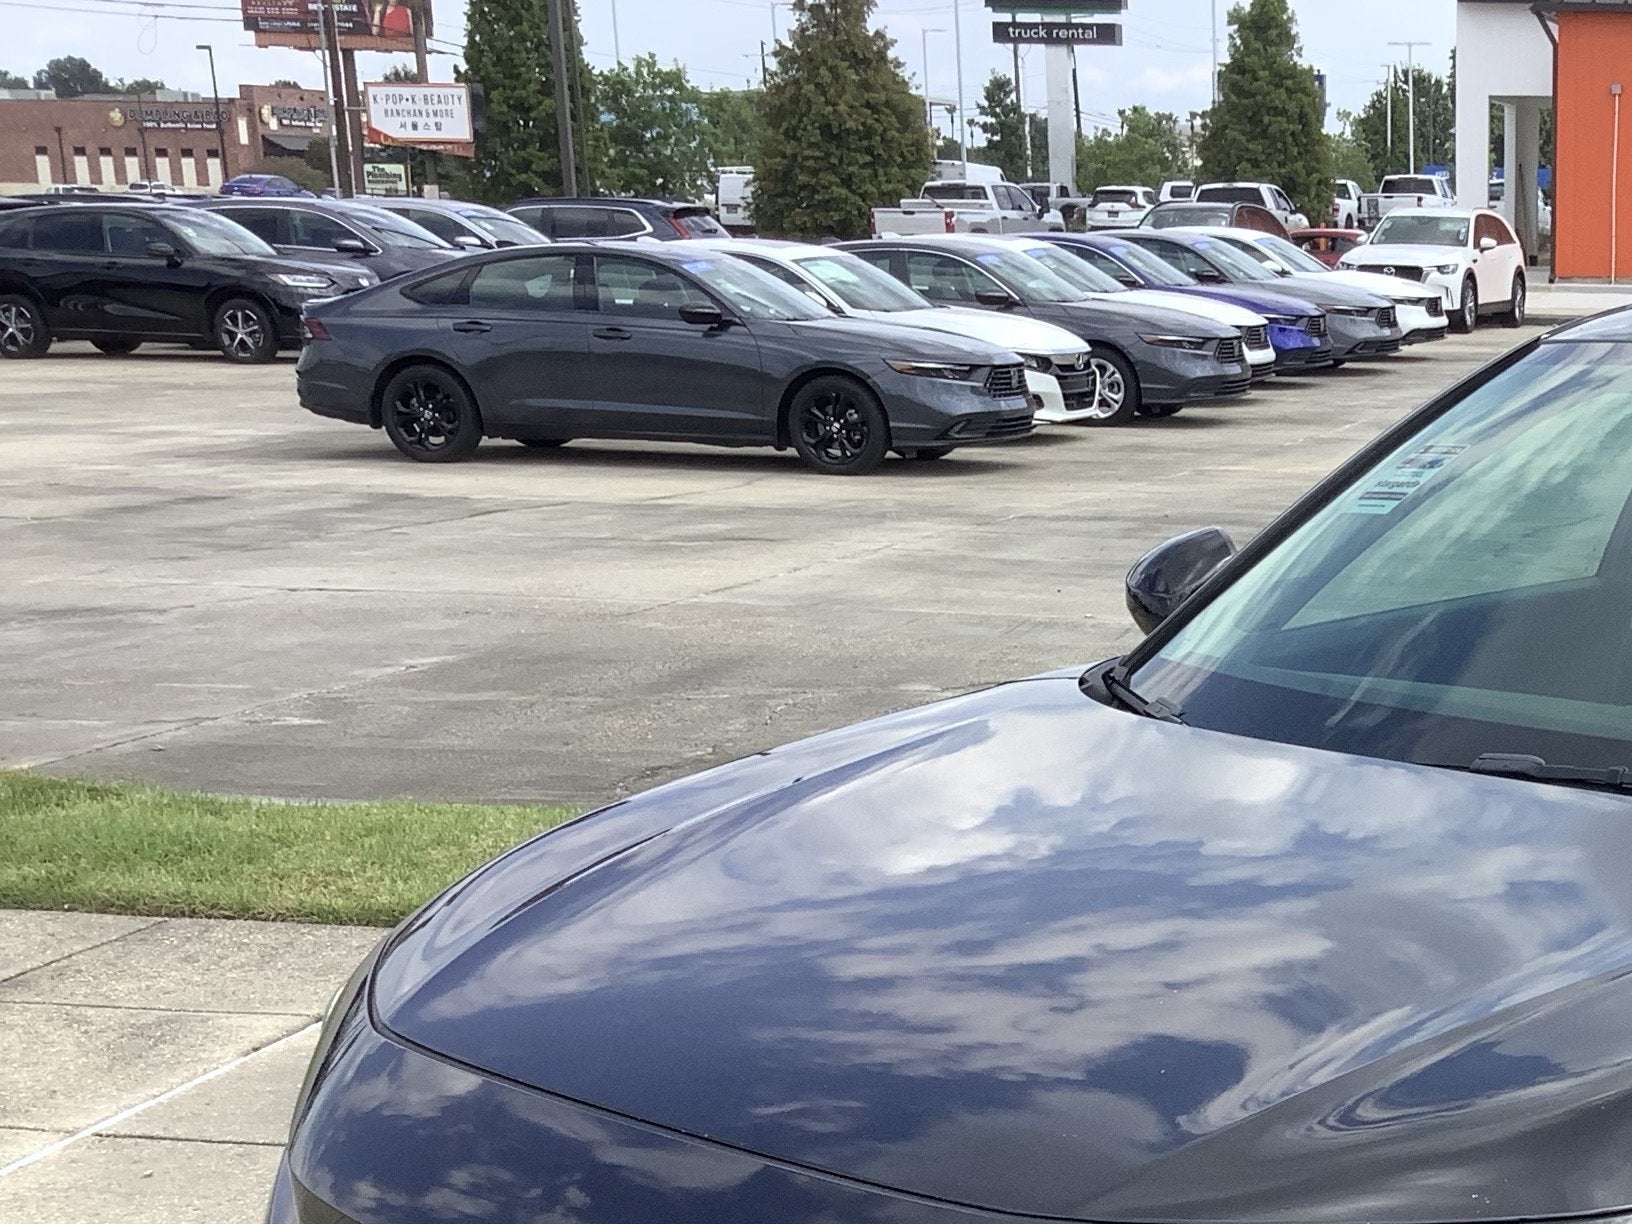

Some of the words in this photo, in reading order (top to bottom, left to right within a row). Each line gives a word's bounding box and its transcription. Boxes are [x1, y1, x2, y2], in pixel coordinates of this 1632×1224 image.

[1008, 25, 1048, 39] truck
[1052, 25, 1097, 40] rental
[384, 108, 423, 119] BANCHAN
[432, 108, 455, 119] MORE
